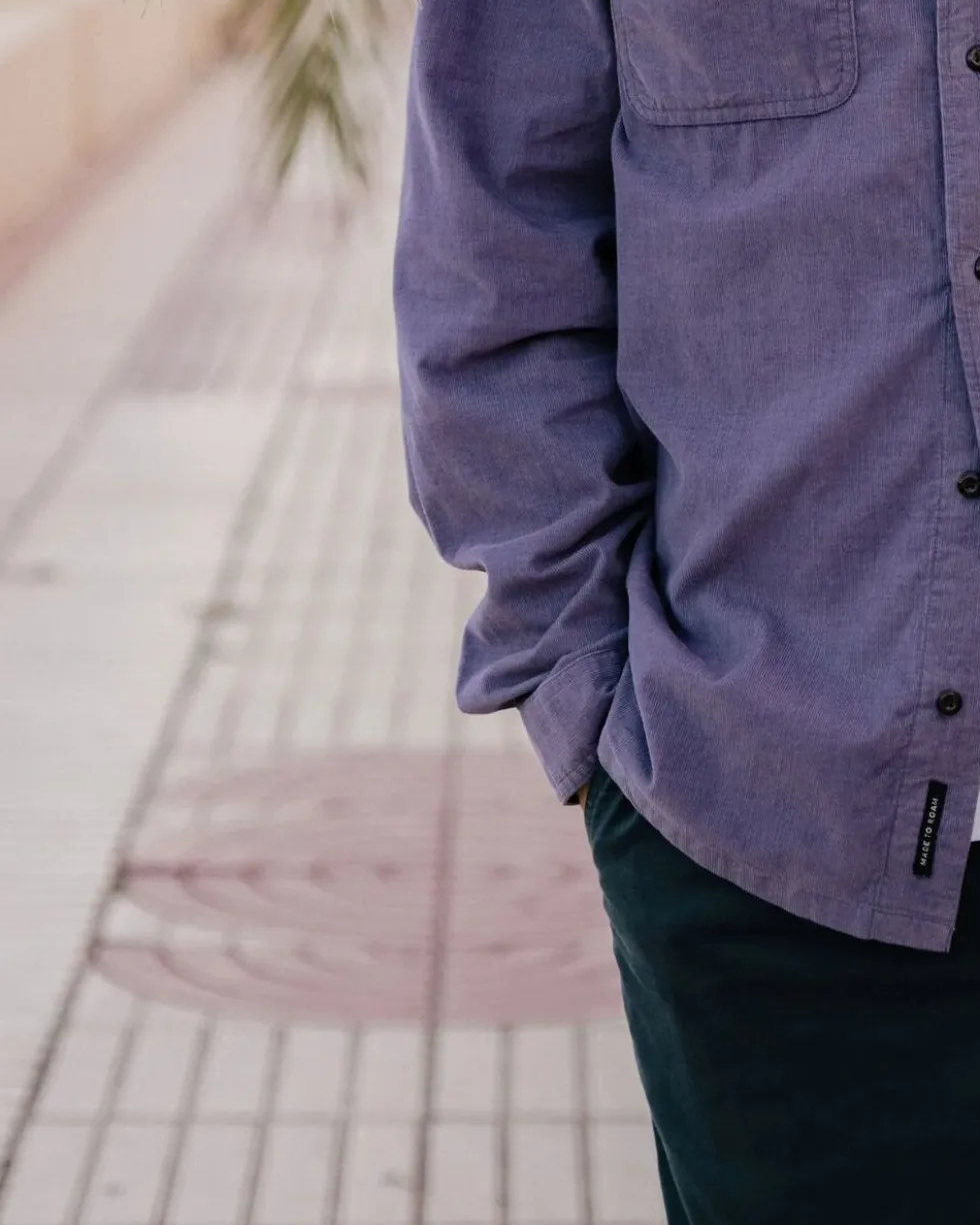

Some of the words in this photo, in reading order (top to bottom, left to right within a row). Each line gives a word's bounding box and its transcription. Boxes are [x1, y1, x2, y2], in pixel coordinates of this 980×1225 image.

[927, 797, 939, 825] ROAM
[924, 827, 933, 838] TO
[920, 840, 931, 866] MADE
